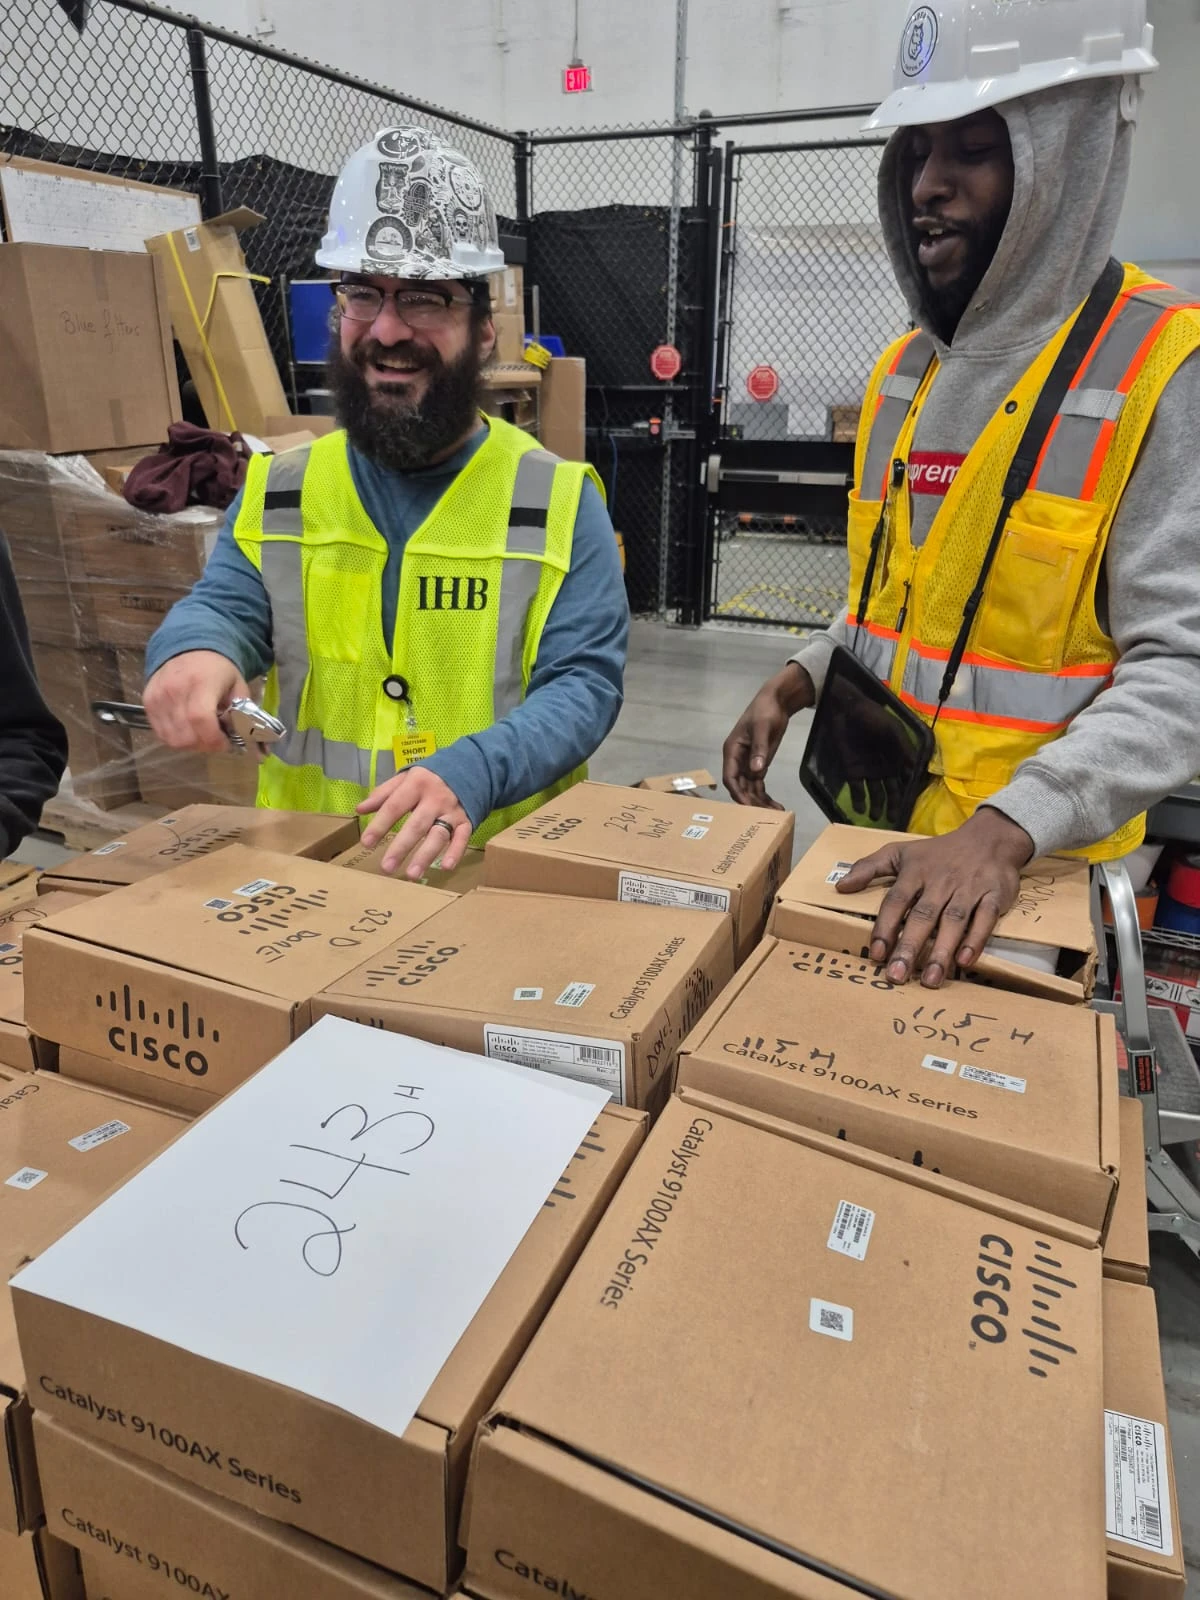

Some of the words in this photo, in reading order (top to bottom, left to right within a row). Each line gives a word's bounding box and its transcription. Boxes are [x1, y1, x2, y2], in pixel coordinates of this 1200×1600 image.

[567, 69, 587, 91] EXIT
[417, 576, 489, 611] IHB
[401, 746, 427, 756] SHORT
[158, 827, 219, 856] CISCO
[541, 817, 583, 840] CISCO
[216, 885, 297, 923] CISCO
[397, 946, 459, 986] CISCO
[609, 985, 649, 1020] Catalyst
[635, 956, 670, 986] 9100AX
[657, 936, 686, 958] Series
[792, 961, 895, 991] CISCO
[107, 1026, 209, 1077] CISCO
[493, 1044, 518, 1054] CISCO
[723, 1042, 807, 1074] Catalyst
[812, 1067, 901, 1100] 9100AX
[906, 1092, 979, 1120] Series
[666, 1117, 714, 1180] Catalyst
[234, 1103, 435, 1276] 243
[631, 1177, 683, 1251] 9100AX
[599, 1248, 648, 1311] Series
[970, 1233, 1014, 1344] CISCO
[39, 1374, 127, 1428] Catalyst
[130, 1415, 223, 1470] 9100AX
[227, 1457, 303, 1505] Series
[1134, 1424, 1143, 1446] CISCO
[61, 1507, 143, 1563] Catalyst
